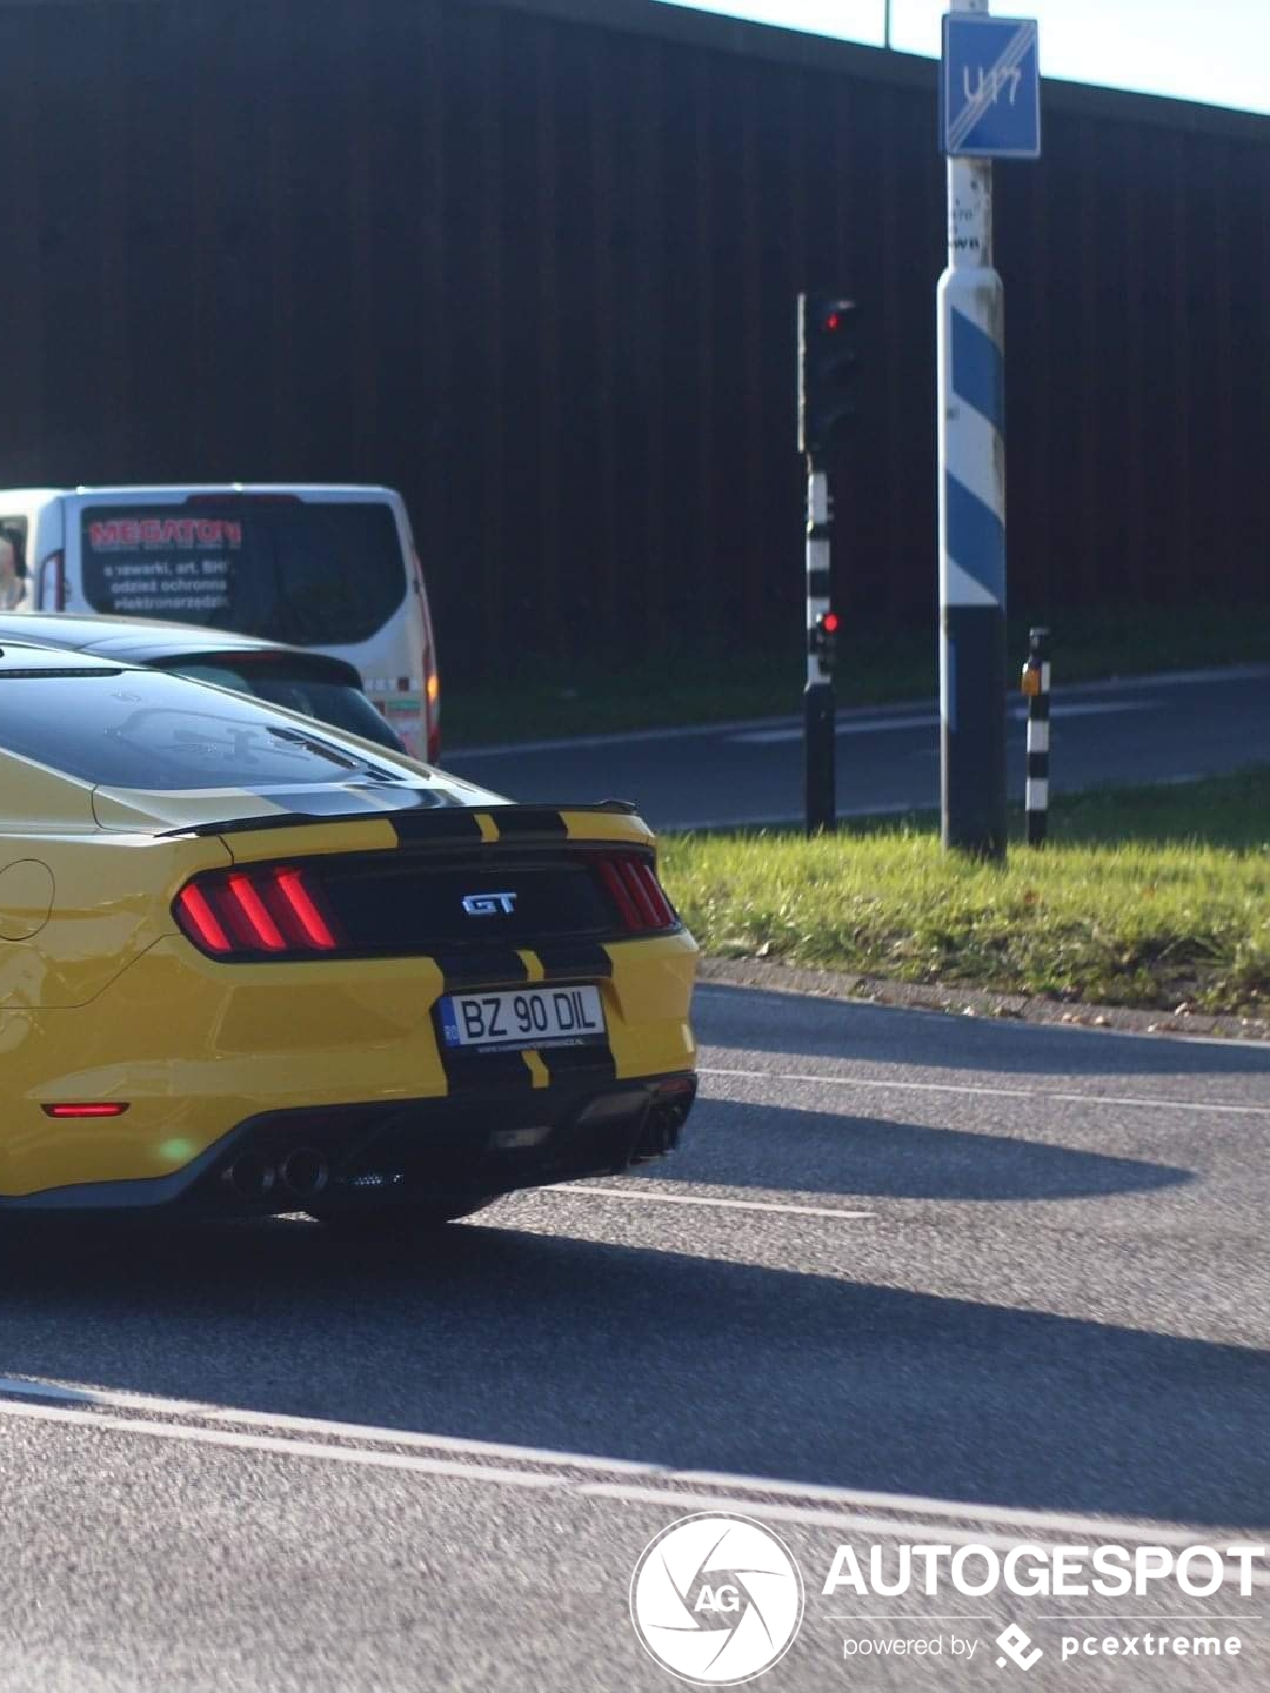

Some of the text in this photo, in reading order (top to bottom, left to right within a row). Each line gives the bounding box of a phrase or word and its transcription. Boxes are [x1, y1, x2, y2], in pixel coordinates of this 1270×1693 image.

[90, 518, 242, 546] MEGATON
[461, 892, 518, 916] GT
[461, 991, 596, 1039] BZ 90 DIL
